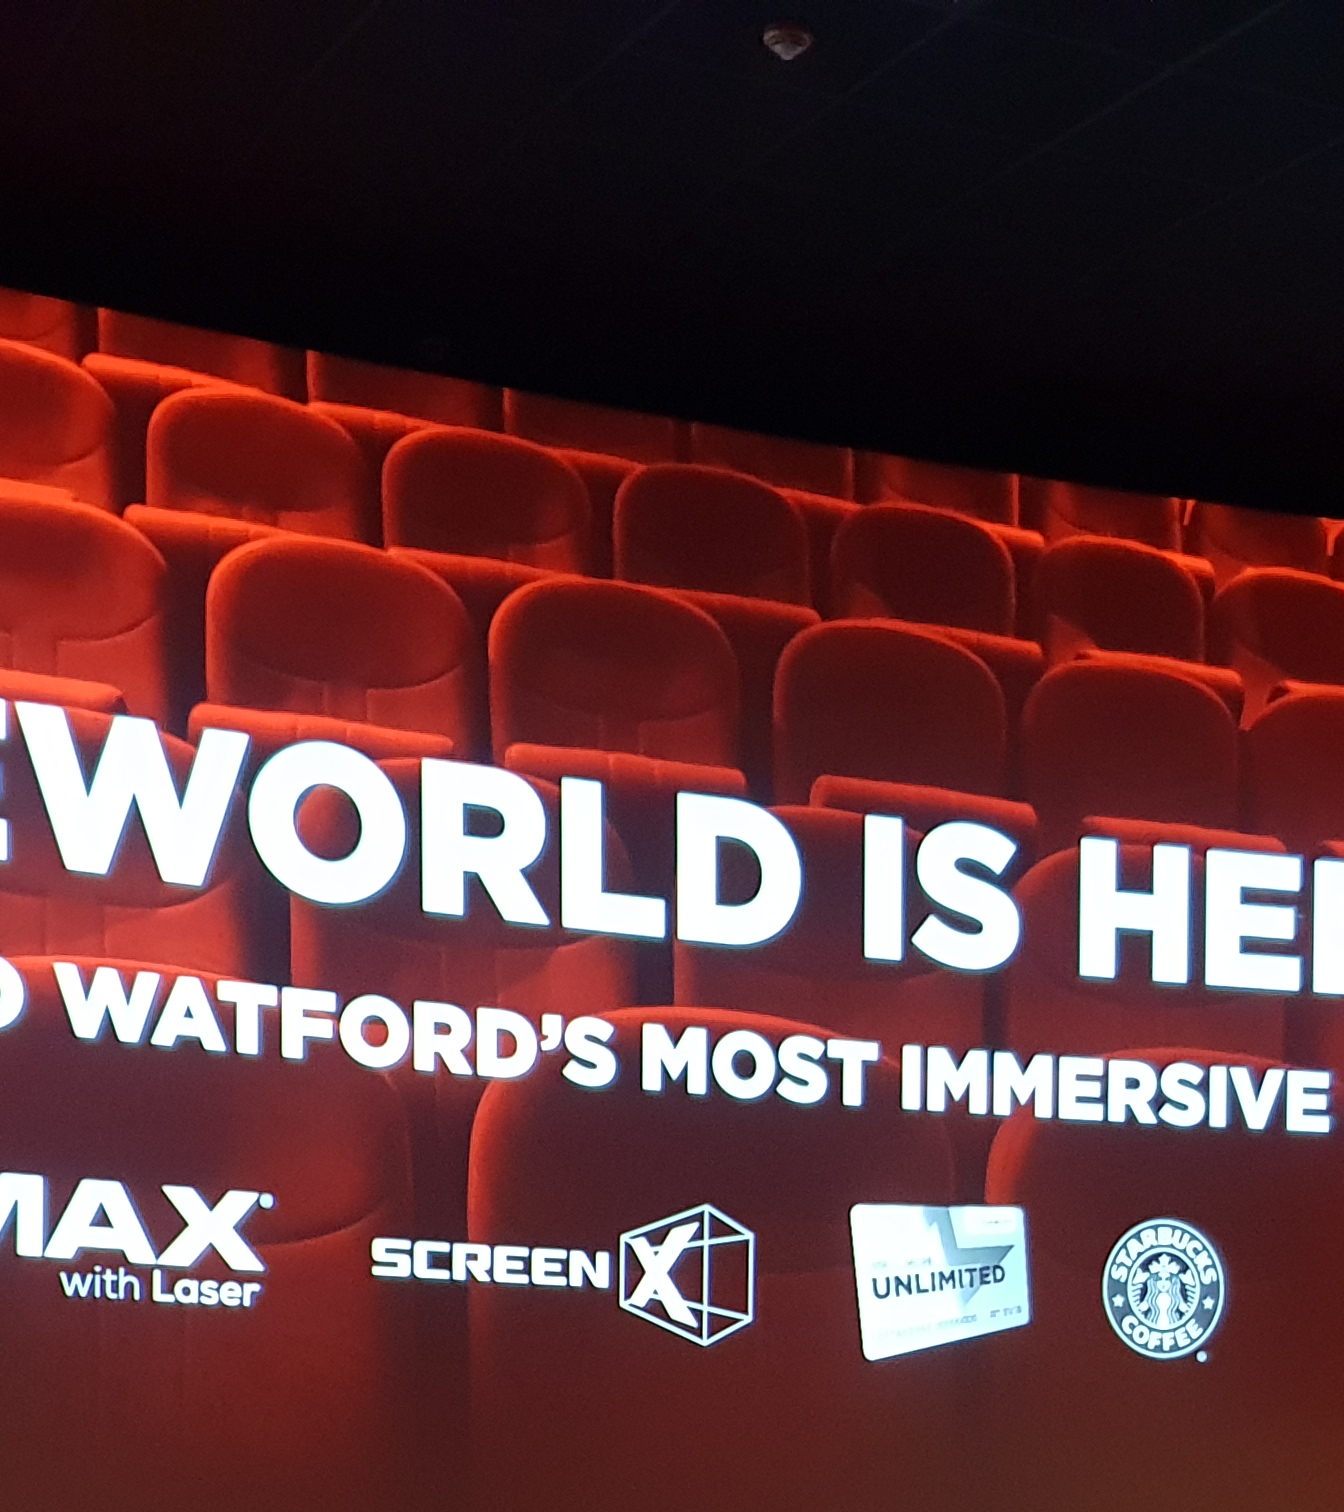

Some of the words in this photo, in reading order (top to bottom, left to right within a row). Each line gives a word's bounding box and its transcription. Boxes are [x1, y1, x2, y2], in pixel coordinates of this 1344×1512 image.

[863, 814, 1021, 971] IS
[52, 961, 617, 1088] WATFORD'S
[641, 1022, 881, 1107] MOST
[901, 1043, 1333, 1134] IMMERSIVE
[1110, 1226, 1218, 1285] STARBUCKS
[59, 1264, 141, 1301] with
[151, 1268, 263, 1308] Laser
[871, 1264, 1006, 1300] UNLIMITED
[1121, 1318, 1204, 1351] COFFEE
